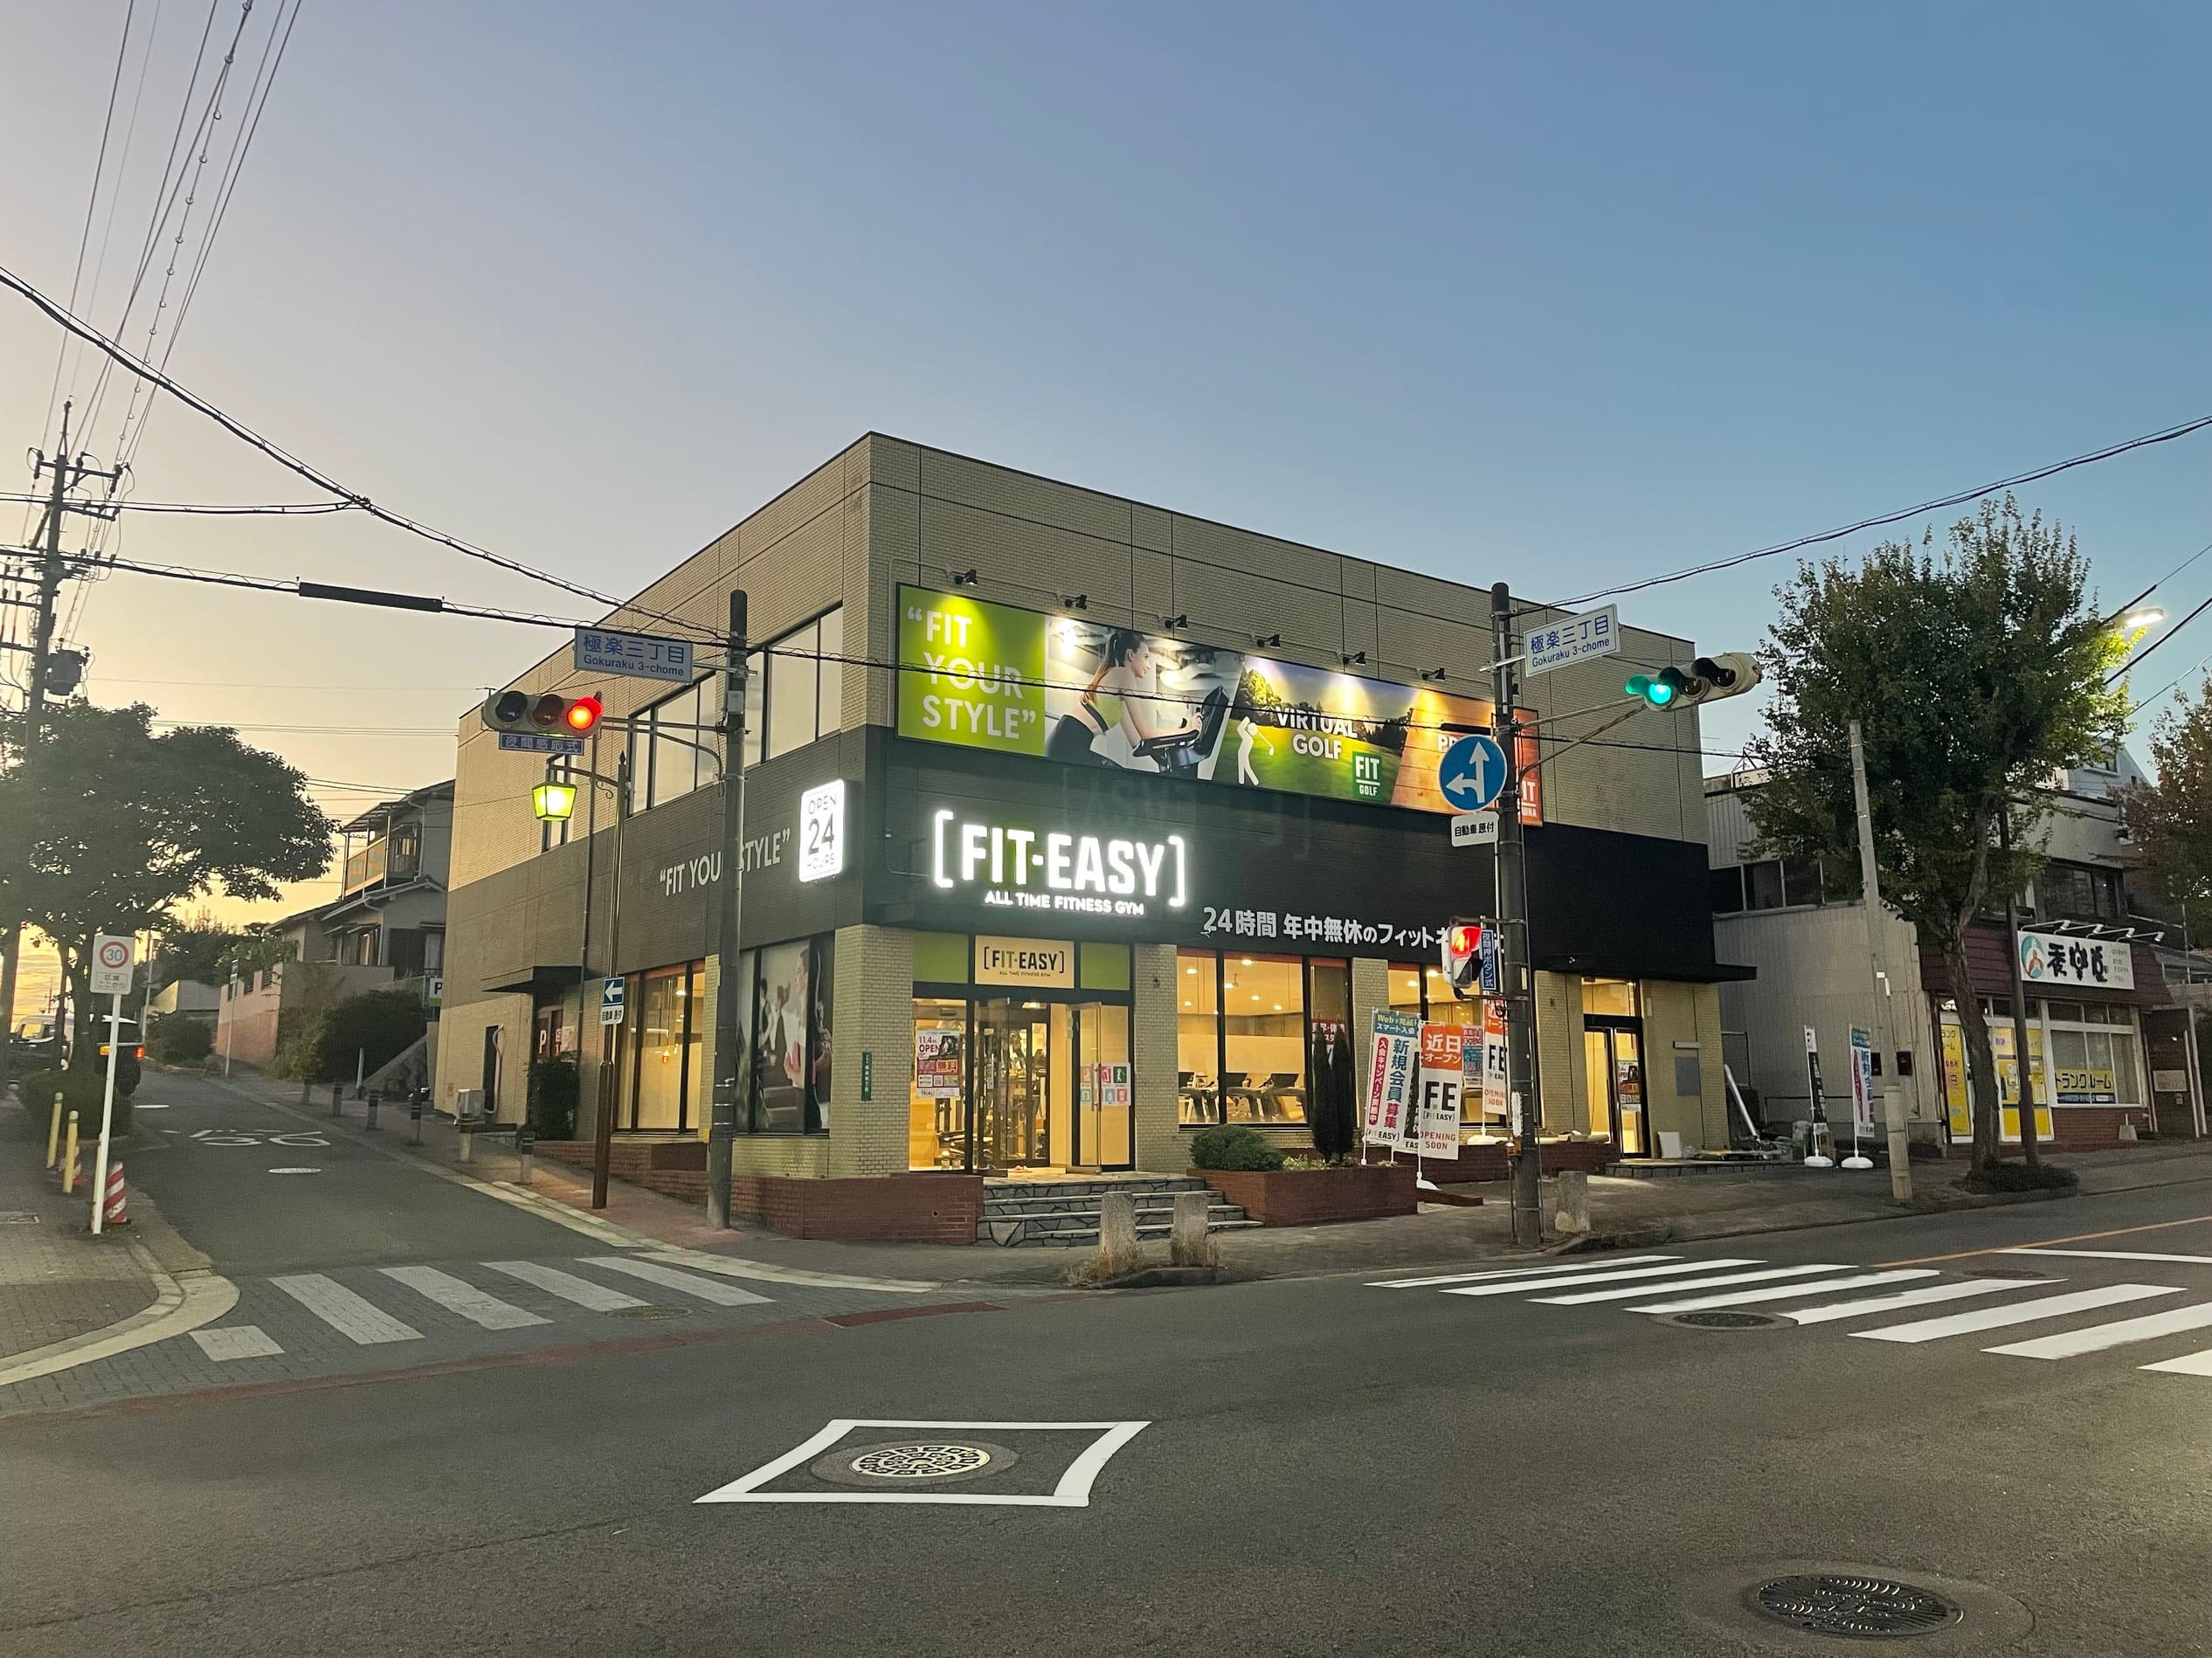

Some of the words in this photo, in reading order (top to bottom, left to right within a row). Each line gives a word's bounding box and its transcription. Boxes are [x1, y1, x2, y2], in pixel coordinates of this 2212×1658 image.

[1531, 614, 1609, 654] 極楽三丁目
[584, 633, 684, 664] 極楽三丁目
[1532, 649, 1570, 667] Gokuraku
[1573, 639, 1610, 656] 3-chome
[584, 655, 634, 670] Gokuraku
[638, 661, 684, 676] 3-chome
[923, 652, 1023, 699] YOUR
[1275, 706, 1358, 738] VIRTUAL
[1292, 734, 1342, 760] GOLF
[1355, 755, 1380, 780] FIT
[808, 791, 836, 815] OPEN
[1359, 784, 1378, 797] GOLF
[1522, 780, 1536, 802] IT
[808, 812, 835, 855] 24
[689, 851, 722, 888] YOU
[984, 890, 1013, 906] ALL
[1015, 892, 1051, 908] TIME
[1054, 895, 1112, 913] FITNESS
[1115, 900, 1144, 915] GYM
[1203, 907, 1276, 938] 24時間
[106, 949, 122, 961] 30
[434, 981, 443, 995] P
[1426, 1033, 1462, 1054] 近日
[1425, 1053, 1462, 1064] オープン
[2055, 1073, 2112, 1089] トランクルーム
